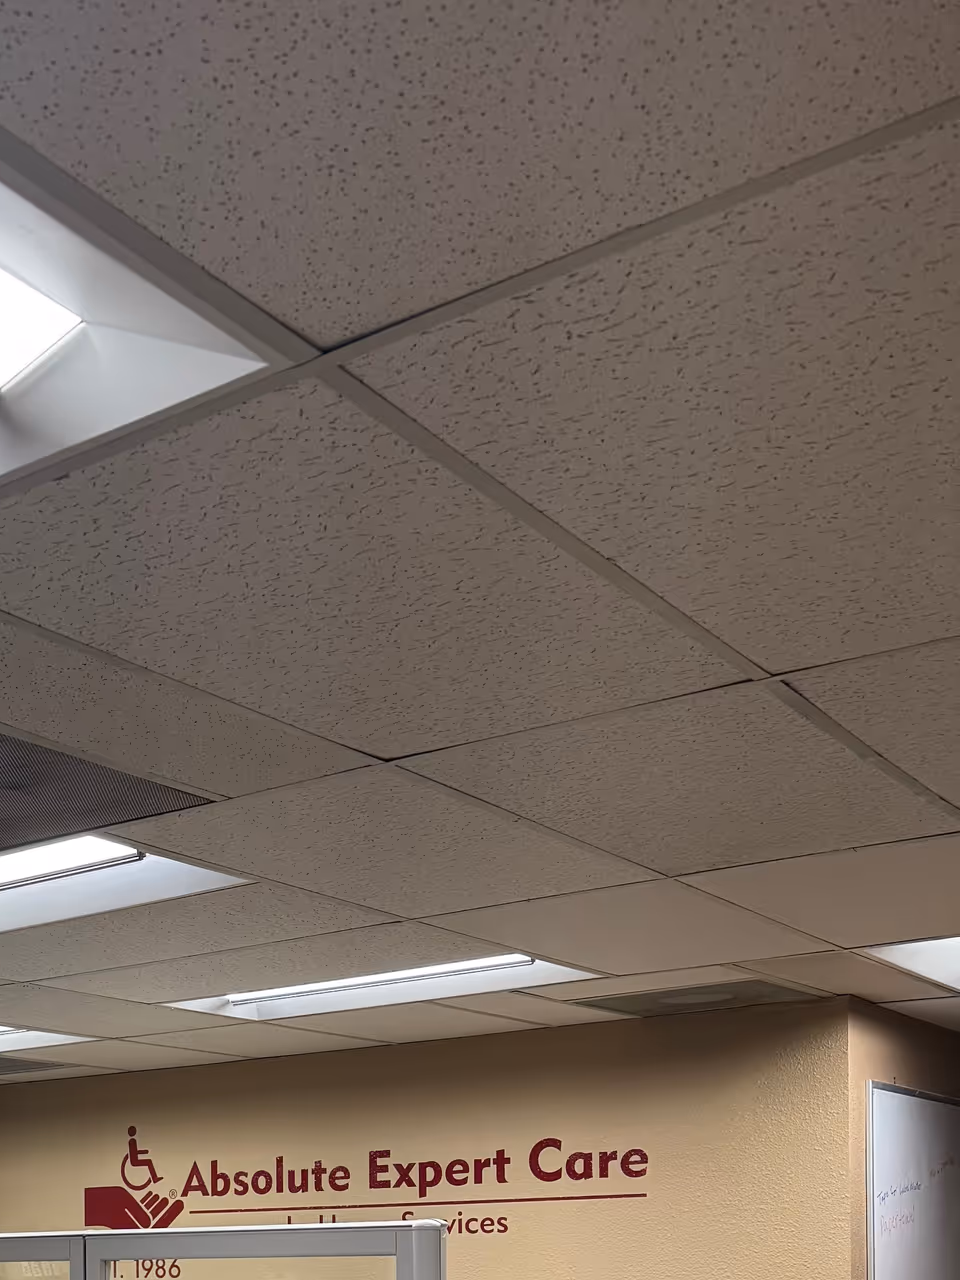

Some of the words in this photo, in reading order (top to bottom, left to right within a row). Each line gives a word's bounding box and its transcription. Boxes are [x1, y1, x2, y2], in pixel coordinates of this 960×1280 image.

[180, 1156, 351, 1198] Absolute
[368, 1149, 511, 1198] Expert
[528, 1137, 649, 1183] Care
[134, 1259, 181, 1279] 1986
